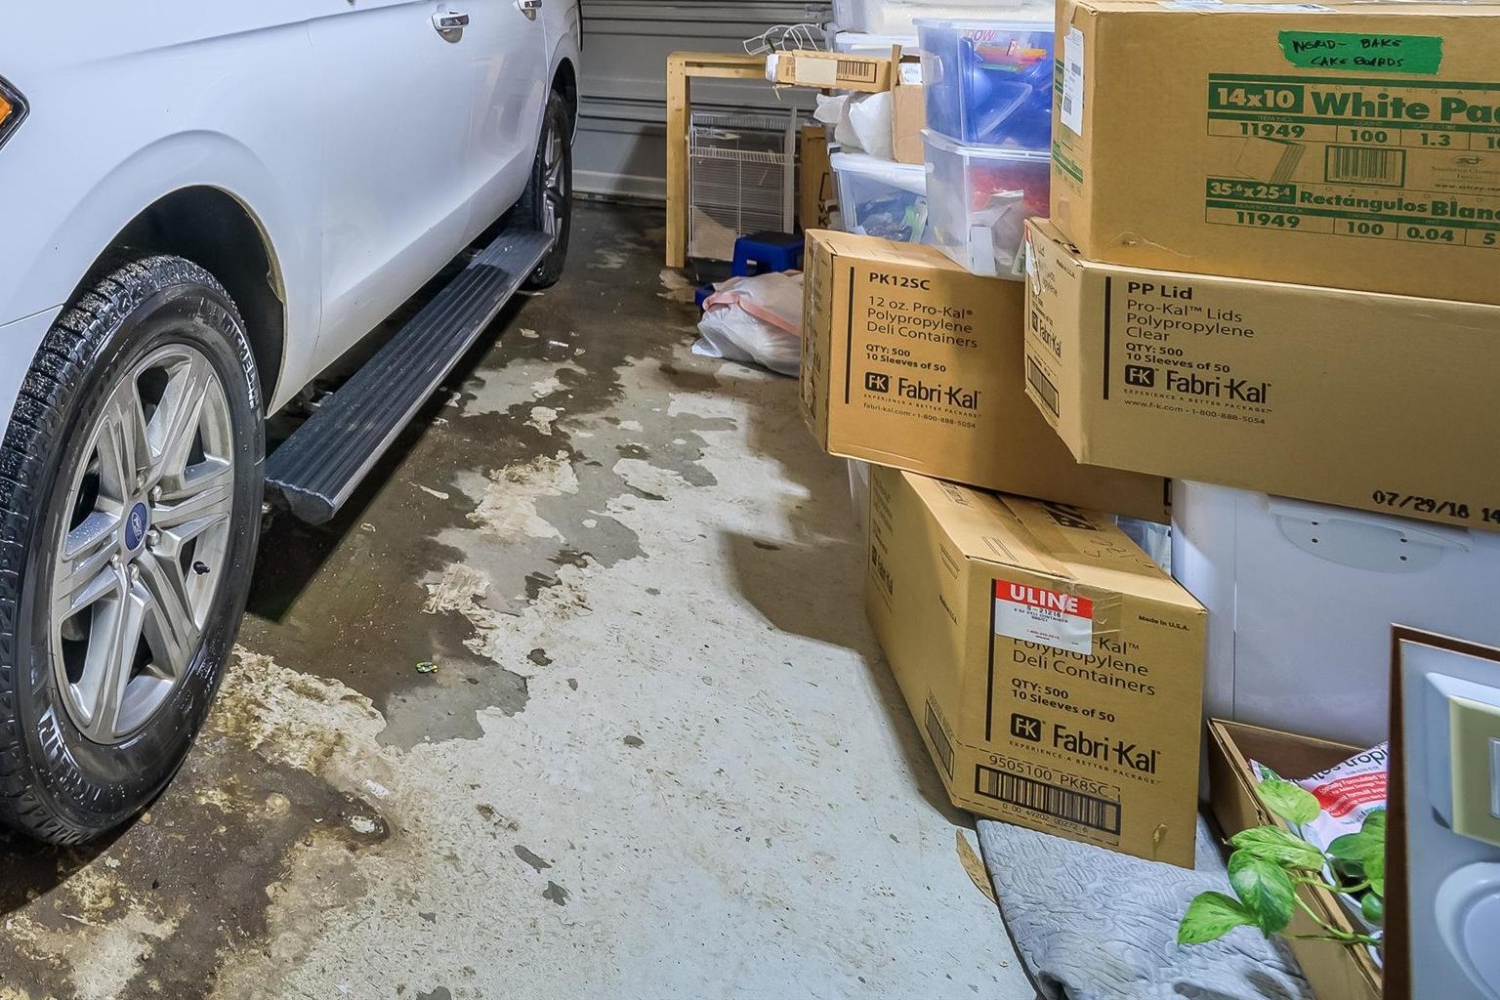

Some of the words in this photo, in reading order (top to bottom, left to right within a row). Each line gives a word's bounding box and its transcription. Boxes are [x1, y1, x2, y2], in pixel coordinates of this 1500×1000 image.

[1217, 87, 1295, 109] 14x10
[1311, 91, 1430, 120] White
[1240, 122, 1305, 138] 11949
[1351, 130, 1388, 143] 100
[1421, 132, 1451, 147] 1.3
[1487, 136, 1500, 149] 1
[1300, 191, 1428, 213] Rectángulos
[1236, 211, 1300, 228] 11949
[1347, 221, 1384, 235] 100
[1407, 226, 1454, 242] 0.04
[869, 272, 931, 291] PK12SC
[1127, 281, 1155, 295] PP
[1160, 284, 1193, 300] Lid
[869, 296, 885, 307] 12
[889, 301, 909, 311] oz.
[867, 308, 973, 333] Polypropylene
[1126, 312, 1255, 338] Polypropylene
[1207, 308, 1243, 323] Lids
[867, 321, 895, 335] Deli
[898, 326, 978, 348] Containers
[1126, 326, 1170, 341] Clear
[866, 343, 890, 354] QTY:
[892, 348, 911, 357] 500
[1125, 342, 1156, 354] QTY:
[1159, 346, 1184, 357] 500
[866, 353, 878, 361] 10
[880, 353, 918, 368] Sleeves
[920, 362, 932, 370] of
[933, 363, 947, 372] 50
[1126, 352, 1142, 361] 10
[1144, 353, 1193, 370] Sleeves
[1196, 362, 1211, 371] of
[1213, 364, 1231, 374] 50
[1124, 400, 1184, 413] www.f-k.com
[1372, 490, 1470, 519] 07/29/18
[1010, 584, 1078, 613] ULINE
[1138, 615, 1159, 625] Made
[1013, 649, 1048, 670] Deli
[1053, 659, 1156, 696] Containers
[1011, 677, 1042, 694] QTY:
[1044, 686, 1069, 699] 500
[1012, 689, 1028, 700] 10
[1029, 692, 1079, 714] Sleeves
[1081, 707, 1096, 718] of
[1098, 711, 1115, 723] 50
[1009, 740, 1063, 760] EXPERIENCE
[1075, 758, 1110, 772] BETTER
[988, 754, 1053, 782] 9505100
[1060, 773, 1109, 798] PK8SC
